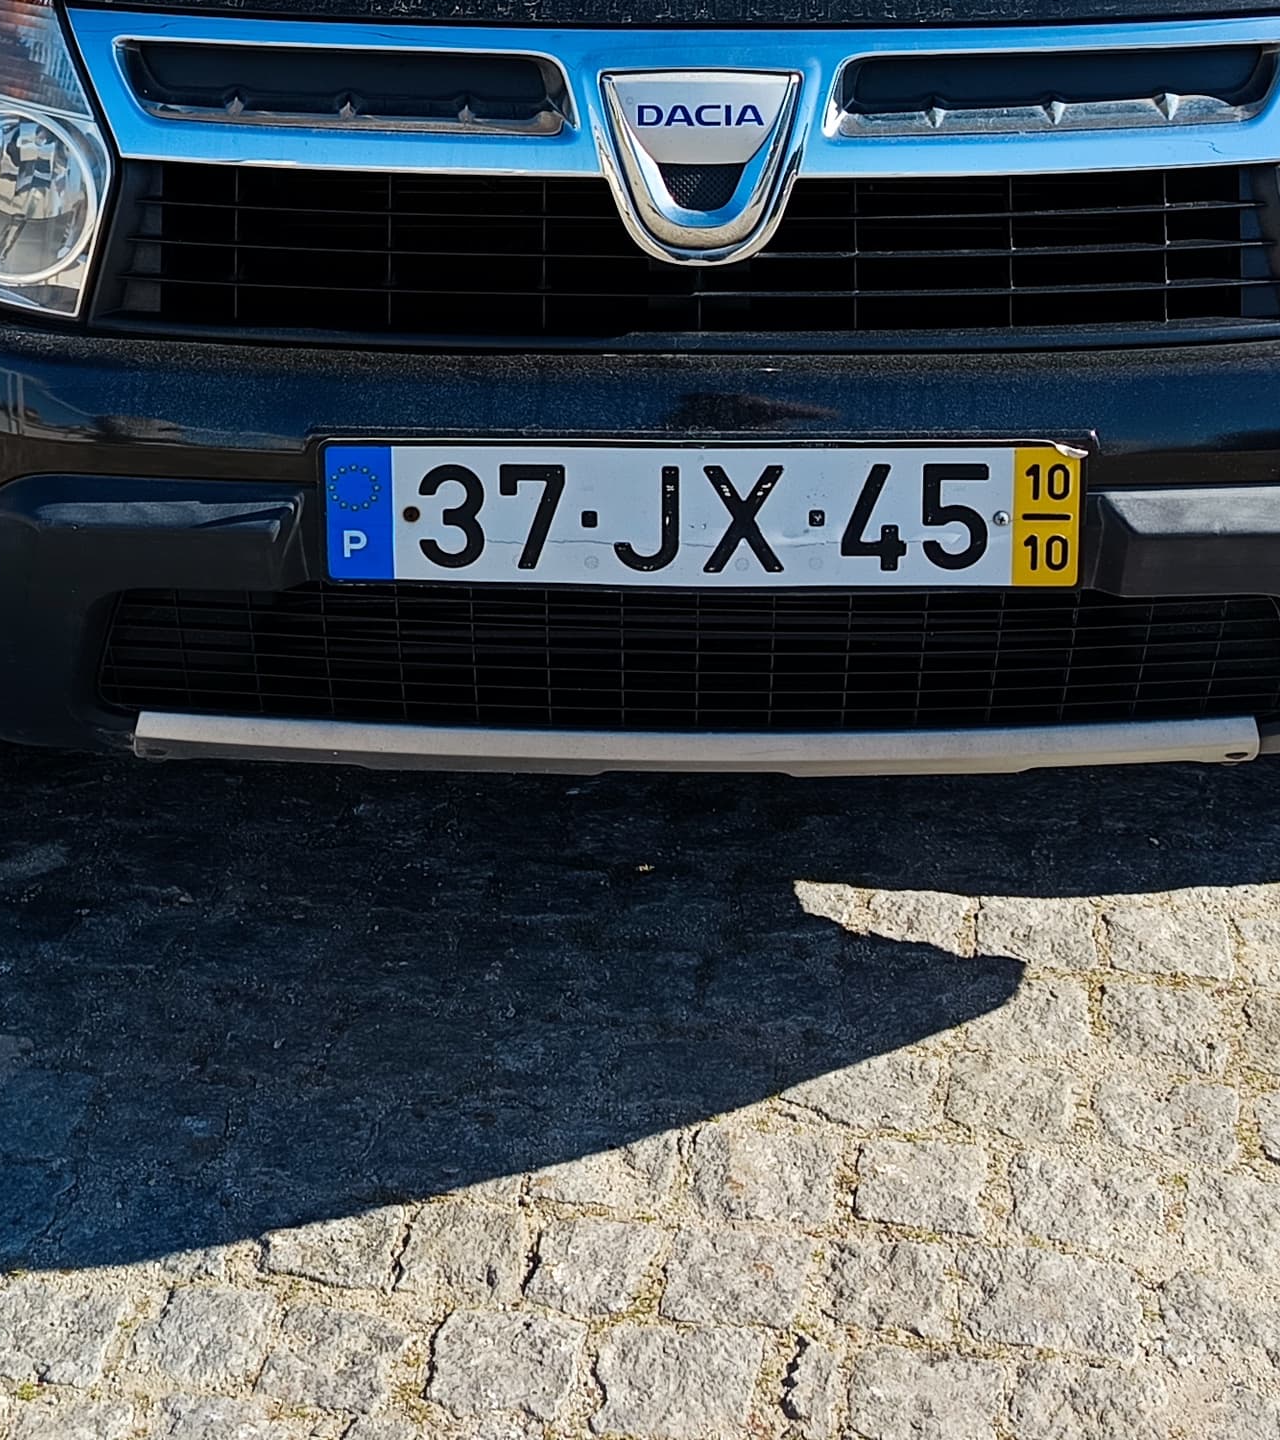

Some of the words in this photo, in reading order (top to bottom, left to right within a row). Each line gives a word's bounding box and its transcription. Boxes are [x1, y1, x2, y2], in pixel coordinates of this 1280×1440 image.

[636, 104, 765, 127] DACIA
[1025, 463, 1070, 501] 10
[342, 529, 369, 558] P
[1023, 534, 1069, 571] 10
